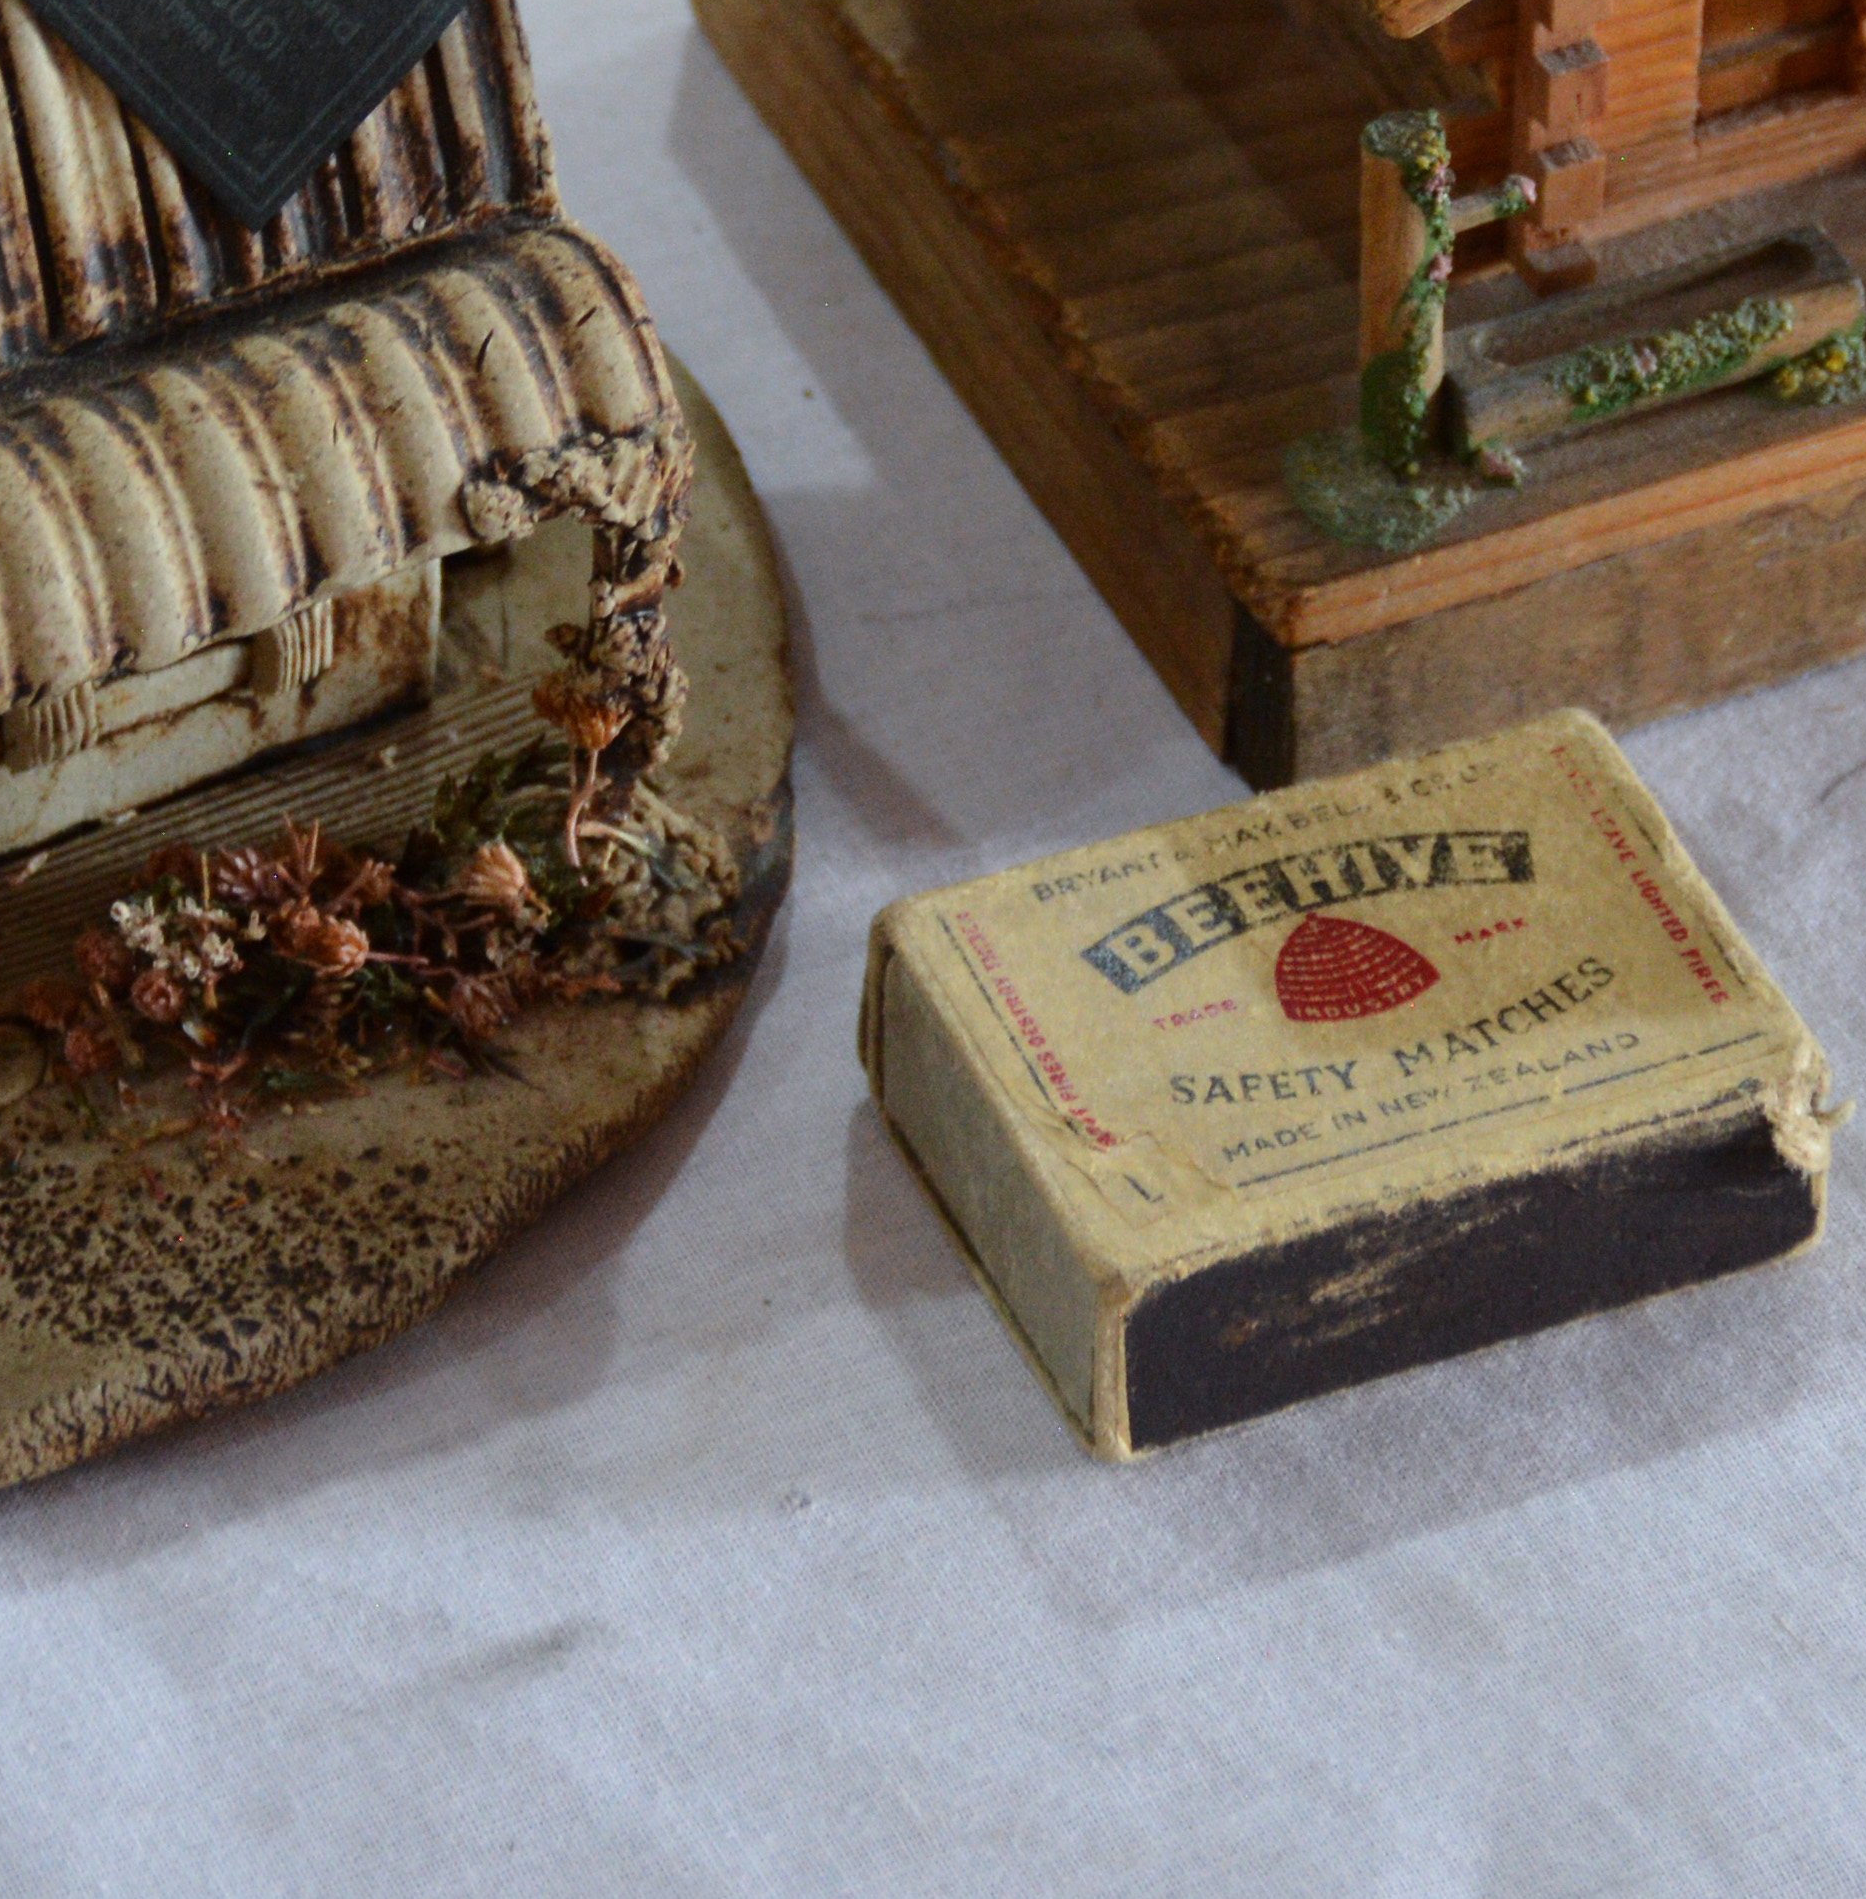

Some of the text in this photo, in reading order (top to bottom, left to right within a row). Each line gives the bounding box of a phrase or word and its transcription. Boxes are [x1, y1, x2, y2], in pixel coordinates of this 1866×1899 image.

[1032, 854, 1161, 903] BRYANT
[1100, 833, 1514, 982] BEEHIVE
[1630, 868, 1689, 943] LIGHTED
[1678, 947, 1730, 1005] FIRES
[1151, 916, 1529, 1032] TRADE MARK
[1168, 955, 1616, 1106] SAFETY MATCHES
[1294, 973, 1426, 1021] INDUSTRY
[1036, 1050, 1081, 1103] FIRES
[1222, 1031, 1642, 1163] MADE IN NEW ZEALAND
